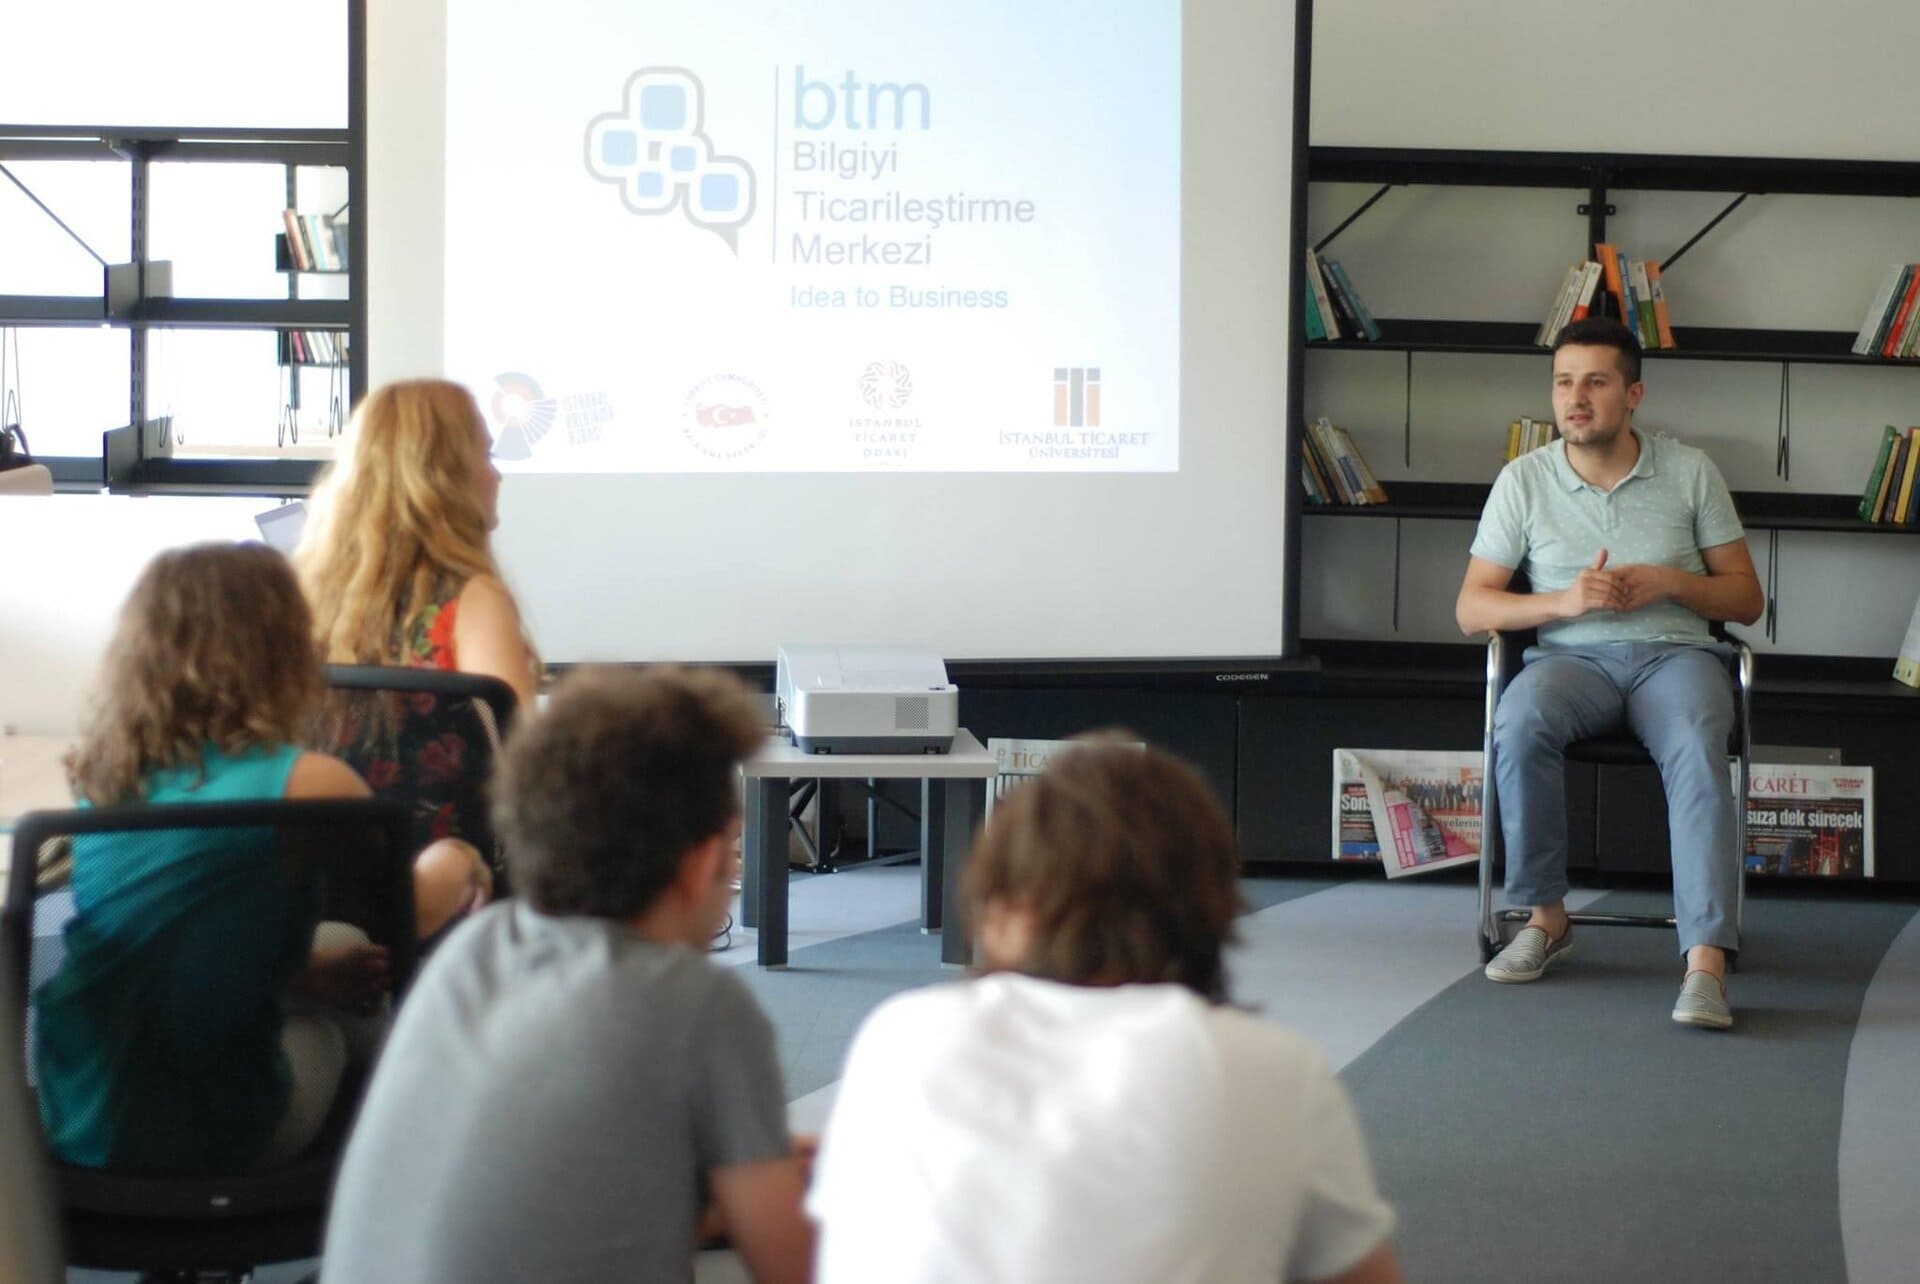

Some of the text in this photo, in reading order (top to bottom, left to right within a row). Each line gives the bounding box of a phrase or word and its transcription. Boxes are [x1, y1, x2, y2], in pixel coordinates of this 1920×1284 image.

[793, 64, 932, 131] btm
[793, 140, 898, 181] Bilgiyi
[792, 190, 1036, 230] Ticarileştirme
[791, 232, 932, 265] Merkezi
[790, 284, 1009, 309] Idea to Business
[1779, 808, 1806, 827] dek
[1807, 809, 1863, 829] sürecek
